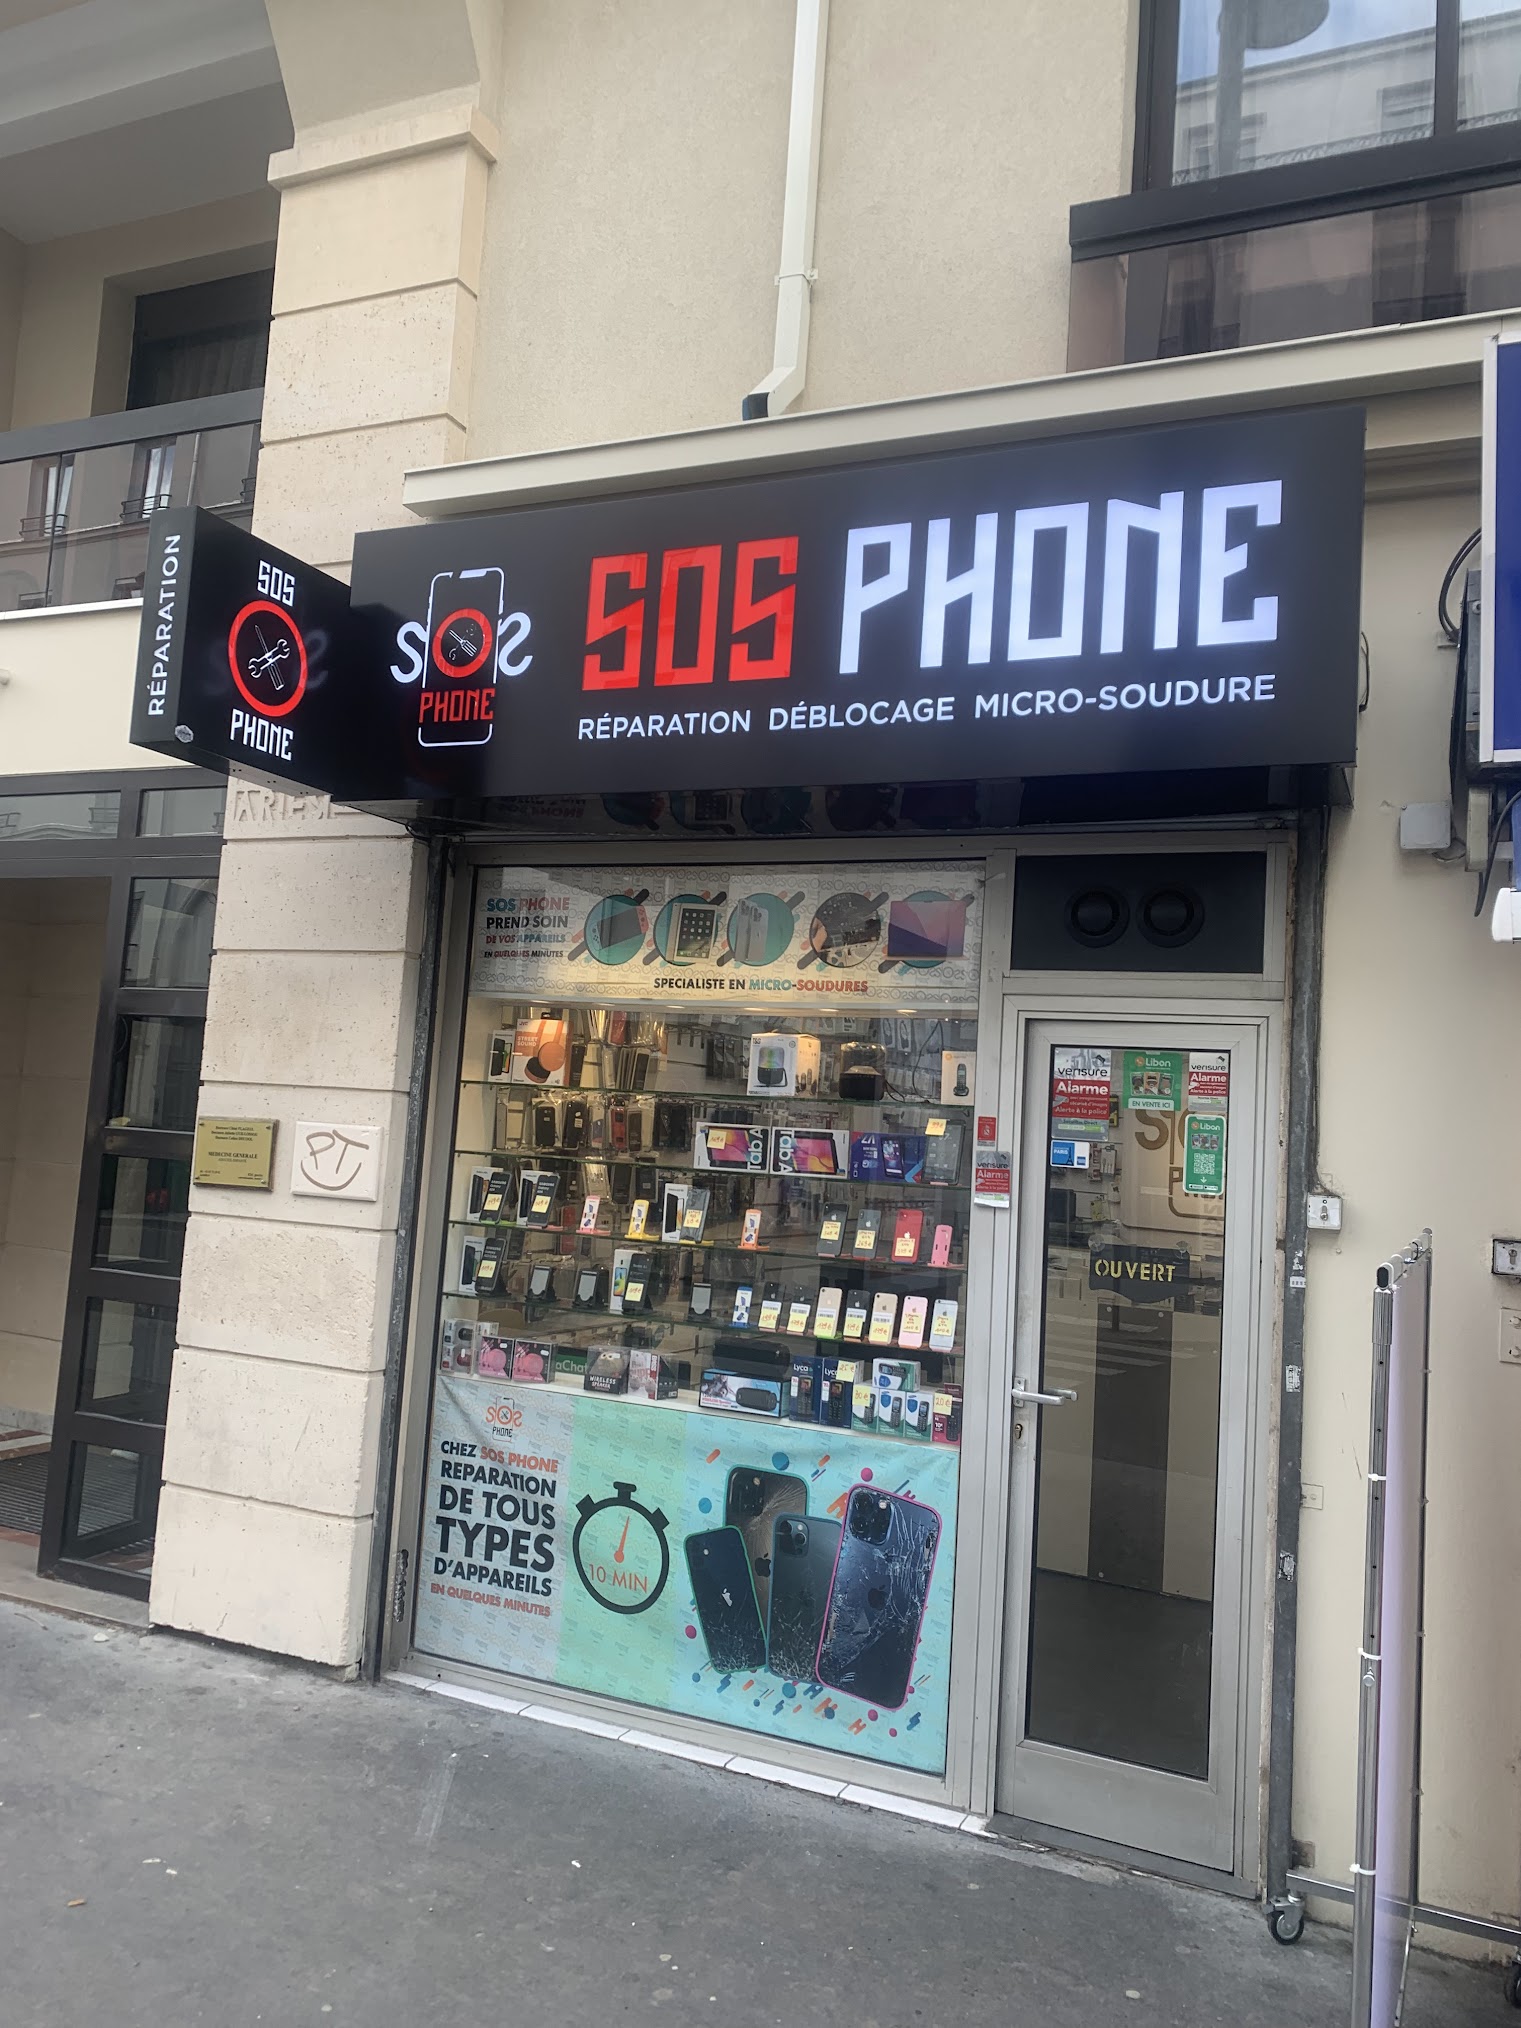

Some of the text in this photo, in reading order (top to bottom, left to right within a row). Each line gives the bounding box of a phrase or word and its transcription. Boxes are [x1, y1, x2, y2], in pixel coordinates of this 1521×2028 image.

[257, 559, 296, 607] SOS
[582, 480, 1283, 691] SOS PHONE
[148, 533, 182, 717] RÉPARATION
[419, 688, 496, 723] PHONE
[578, 674, 1277, 740] RÉPARATION DÉBLOCAGE MICRO-SOUDURE
[230, 710, 294, 762] PHONE
[487, 896, 570, 912] SOS PHONE
[486, 915, 569, 929] PREND SOIN
[485, 933, 565, 944] DE VOS APPAREILS
[494, 950, 530, 958] QUELQUES
[531, 950, 563, 958] MINUTES
[653, 978, 868, 992] SPECIALISTE EN MICRO-SOUDURES
[1057, 1067, 1108, 1077] verisure
[1145, 1057, 1171, 1067] Libon
[1056, 1081, 1108, 1095] Alarme
[1191, 1073, 1227, 1082] Alarme
[1200, 1122, 1220, 1131] Libon
[748, 1128, 764, 1170] Tab A
[778, 1130, 794, 1173] Tab A
[977, 1169, 1009, 1179] Alarme
[1095, 1258, 1176, 1282] OUVERT
[589, 1375, 616, 1385] WIRELESS
[793, 1363, 809, 1372] Lyca
[492, 1426, 513, 1438] PHONE
[441, 1440, 559, 1473] CHEZ SOS PHONE
[441, 1460, 557, 1499] REPARATION
[439, 1484, 556, 1530] DE TOUS
[436, 1516, 554, 1572] TYPES
[434, 1557, 552, 1597] D'APPAREILS
[589, 1563, 648, 1593] 10 MIN
[431, 1582, 551, 1617] EN QUELQUES MINUTES
